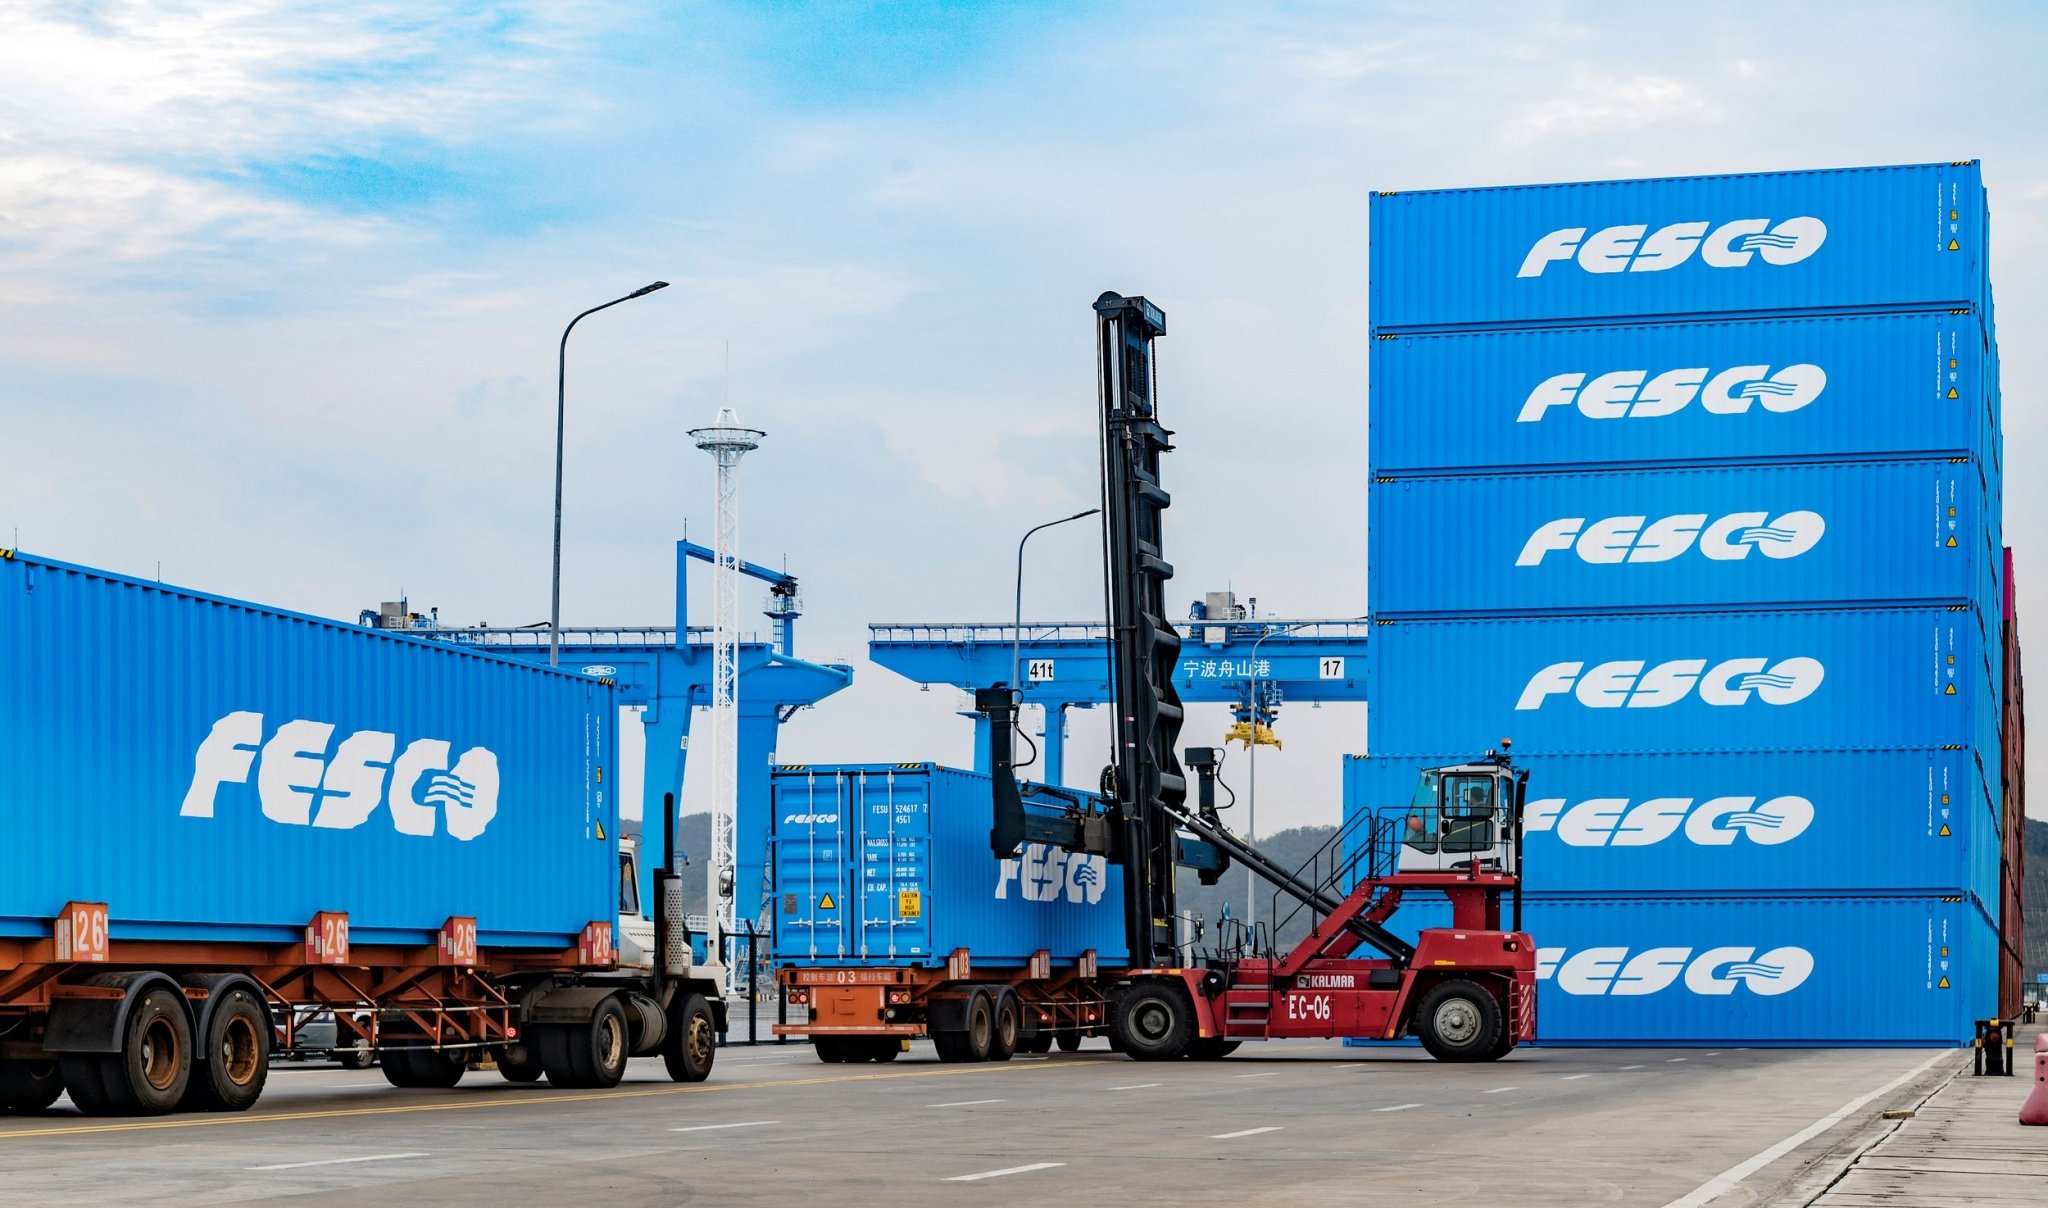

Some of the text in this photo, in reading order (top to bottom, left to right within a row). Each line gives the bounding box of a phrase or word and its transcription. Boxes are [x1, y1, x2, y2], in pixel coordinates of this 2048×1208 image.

[1517, 217, 1827, 278] FESCO
[1516, 363, 1827, 423] FESCO
[1515, 510, 1826, 566] FESCO
[1029, 662, 1054, 679] 41t
[1183, 660, 1271, 678] 宁波舟山港
[1323, 660, 1341, 676] 17
[1515, 657, 1825, 710] FESCO
[179, 710, 500, 841] FESCO
[872, 805, 888, 814] FESU
[895, 804, 918, 813] 524617
[895, 815, 911, 824] 45G1
[1522, 796, 1815, 847] FESCO
[326, 919, 346, 955] 26
[457, 924, 473, 957] 26
[595, 927, 609, 957] 26
[837, 970, 856, 983] 03
[1311, 975, 1355, 988] KALMAR
[1289, 995, 1330, 1020] EC-06
